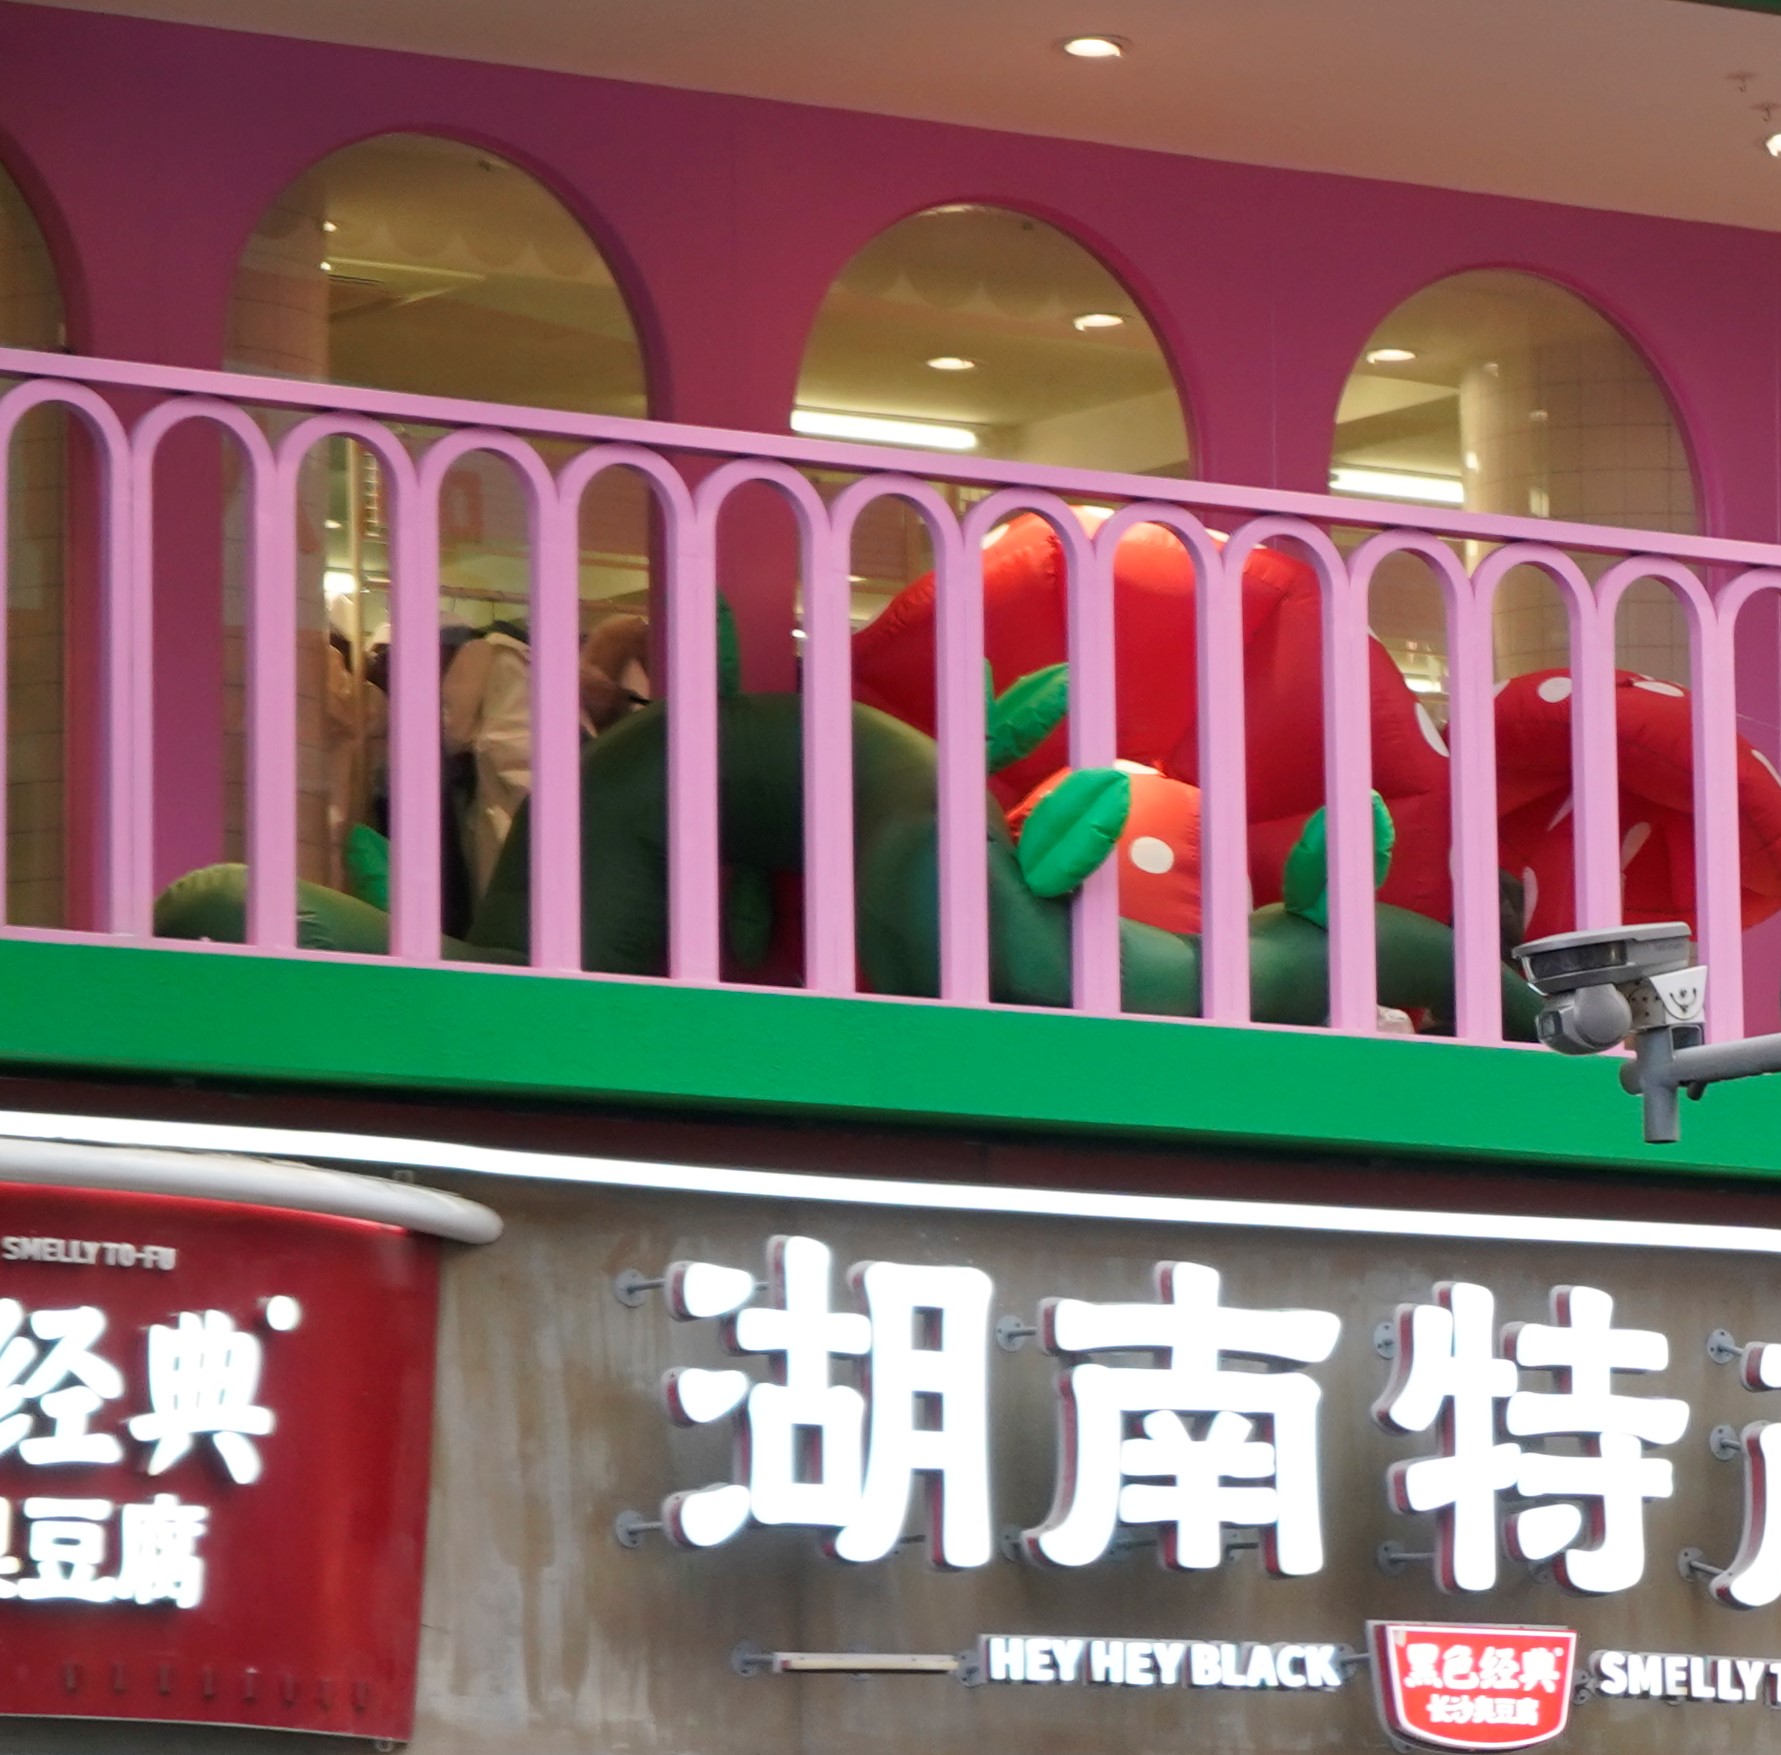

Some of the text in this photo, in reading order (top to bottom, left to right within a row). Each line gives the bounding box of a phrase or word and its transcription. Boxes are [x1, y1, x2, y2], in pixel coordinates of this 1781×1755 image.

[2, 1237, 98, 1265] SMELLY
[0, 1297, 276, 1485] 经典
[0, 1494, 210, 1609] 豆腐
[989, 1637, 1342, 1689] HEY HEY BLACK
[1600, 1651, 1764, 1701] SMELLY
